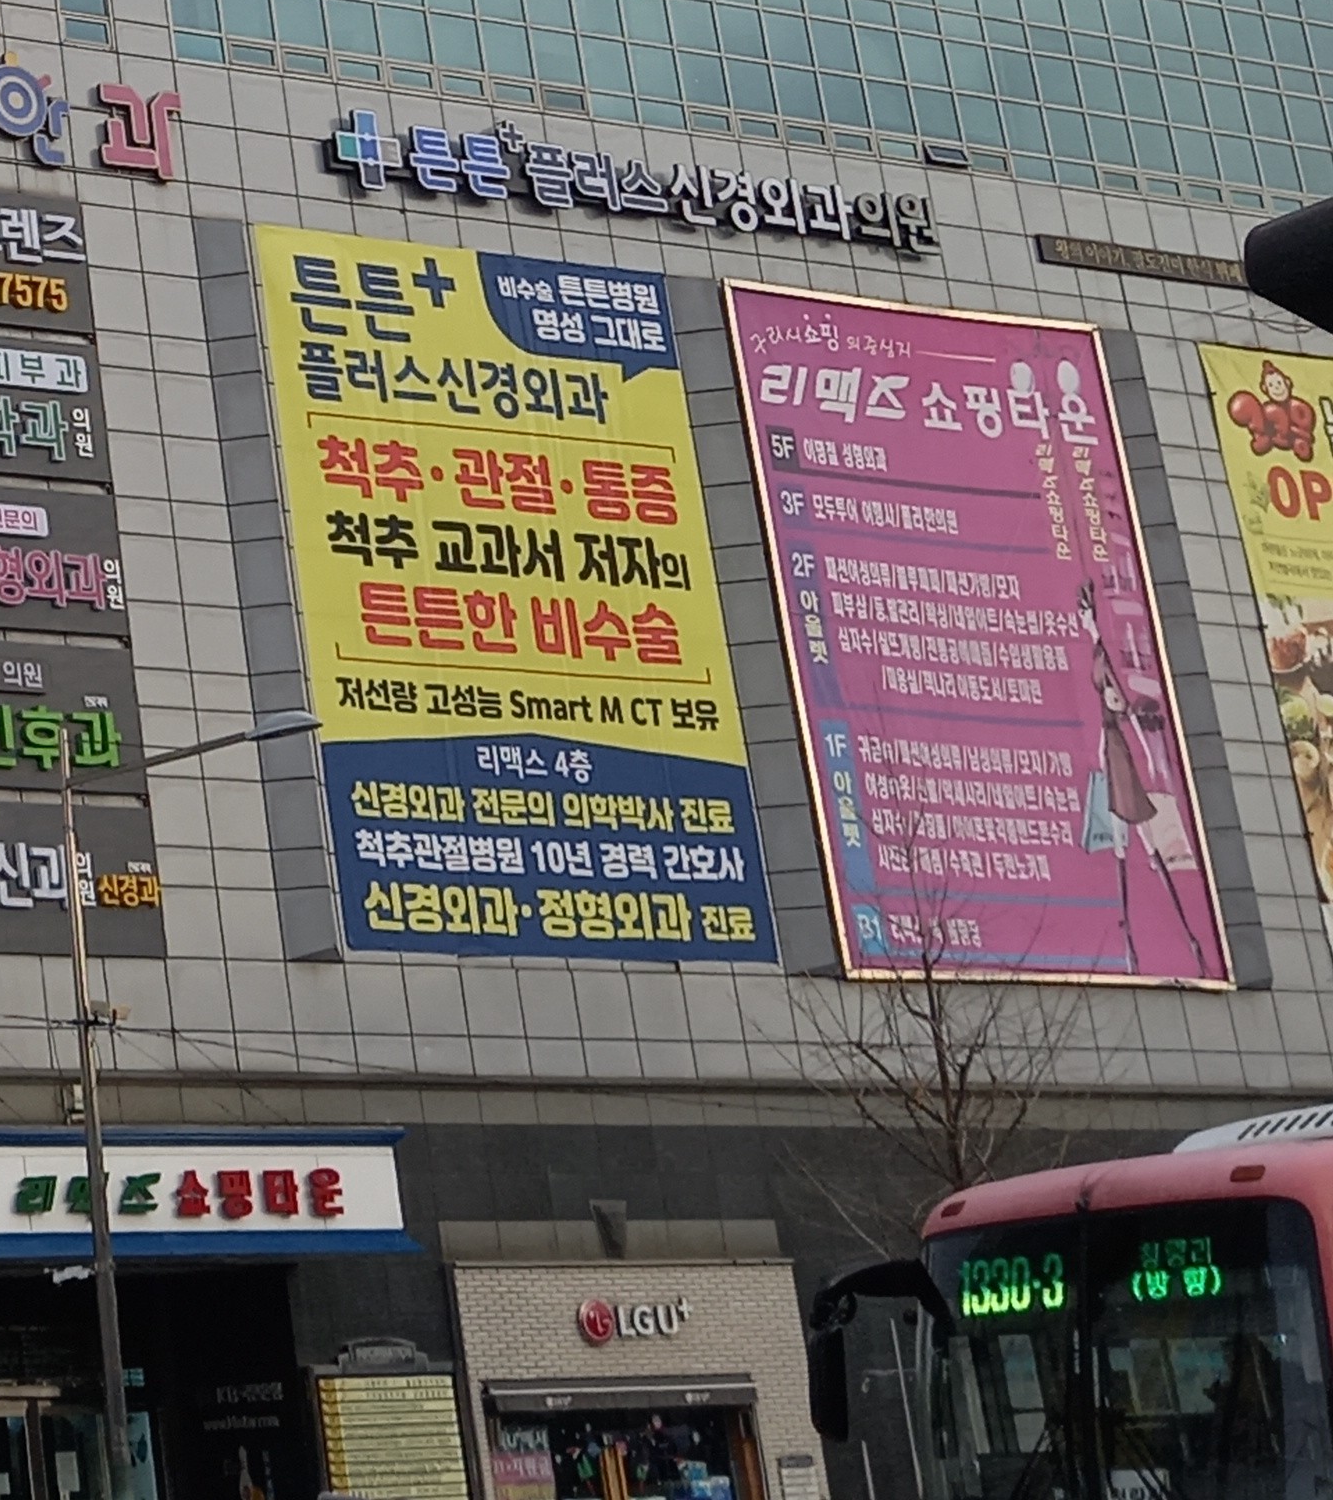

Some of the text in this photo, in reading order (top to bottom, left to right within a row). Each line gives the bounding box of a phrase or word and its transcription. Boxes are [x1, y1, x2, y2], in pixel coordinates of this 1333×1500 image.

[496, 275, 662, 315] 비수술 튼튼병원
[533, 310, 667, 353] 명성 그대로
[761, 364, 910, 422] 리맥스
[72, 408, 94, 458] 의원
[772, 435, 794, 459] 5F
[781, 490, 804, 516] 3F
[326, 510, 692, 592] 척추 교과서 저자의
[792, 553, 815, 577] 2F
[359, 581, 683, 666] 튼튼한 비수술
[3, 660, 44, 689] 의원
[336, 677, 720, 731] 저선량 고성능 Smart M CT 보유
[476, 745, 593, 783] 리맥스 4층
[824, 734, 847, 759] 1F
[351, 781, 735, 834] 신경외과 전문의 의학박사 진료
[355, 829, 745, 883] 척추관절병원 10년 경력 간호사
[97, 873, 163, 908] 신경과
[701, 905, 757, 943] 진료
[175, 1168, 344, 1220] 쇼핑타운
